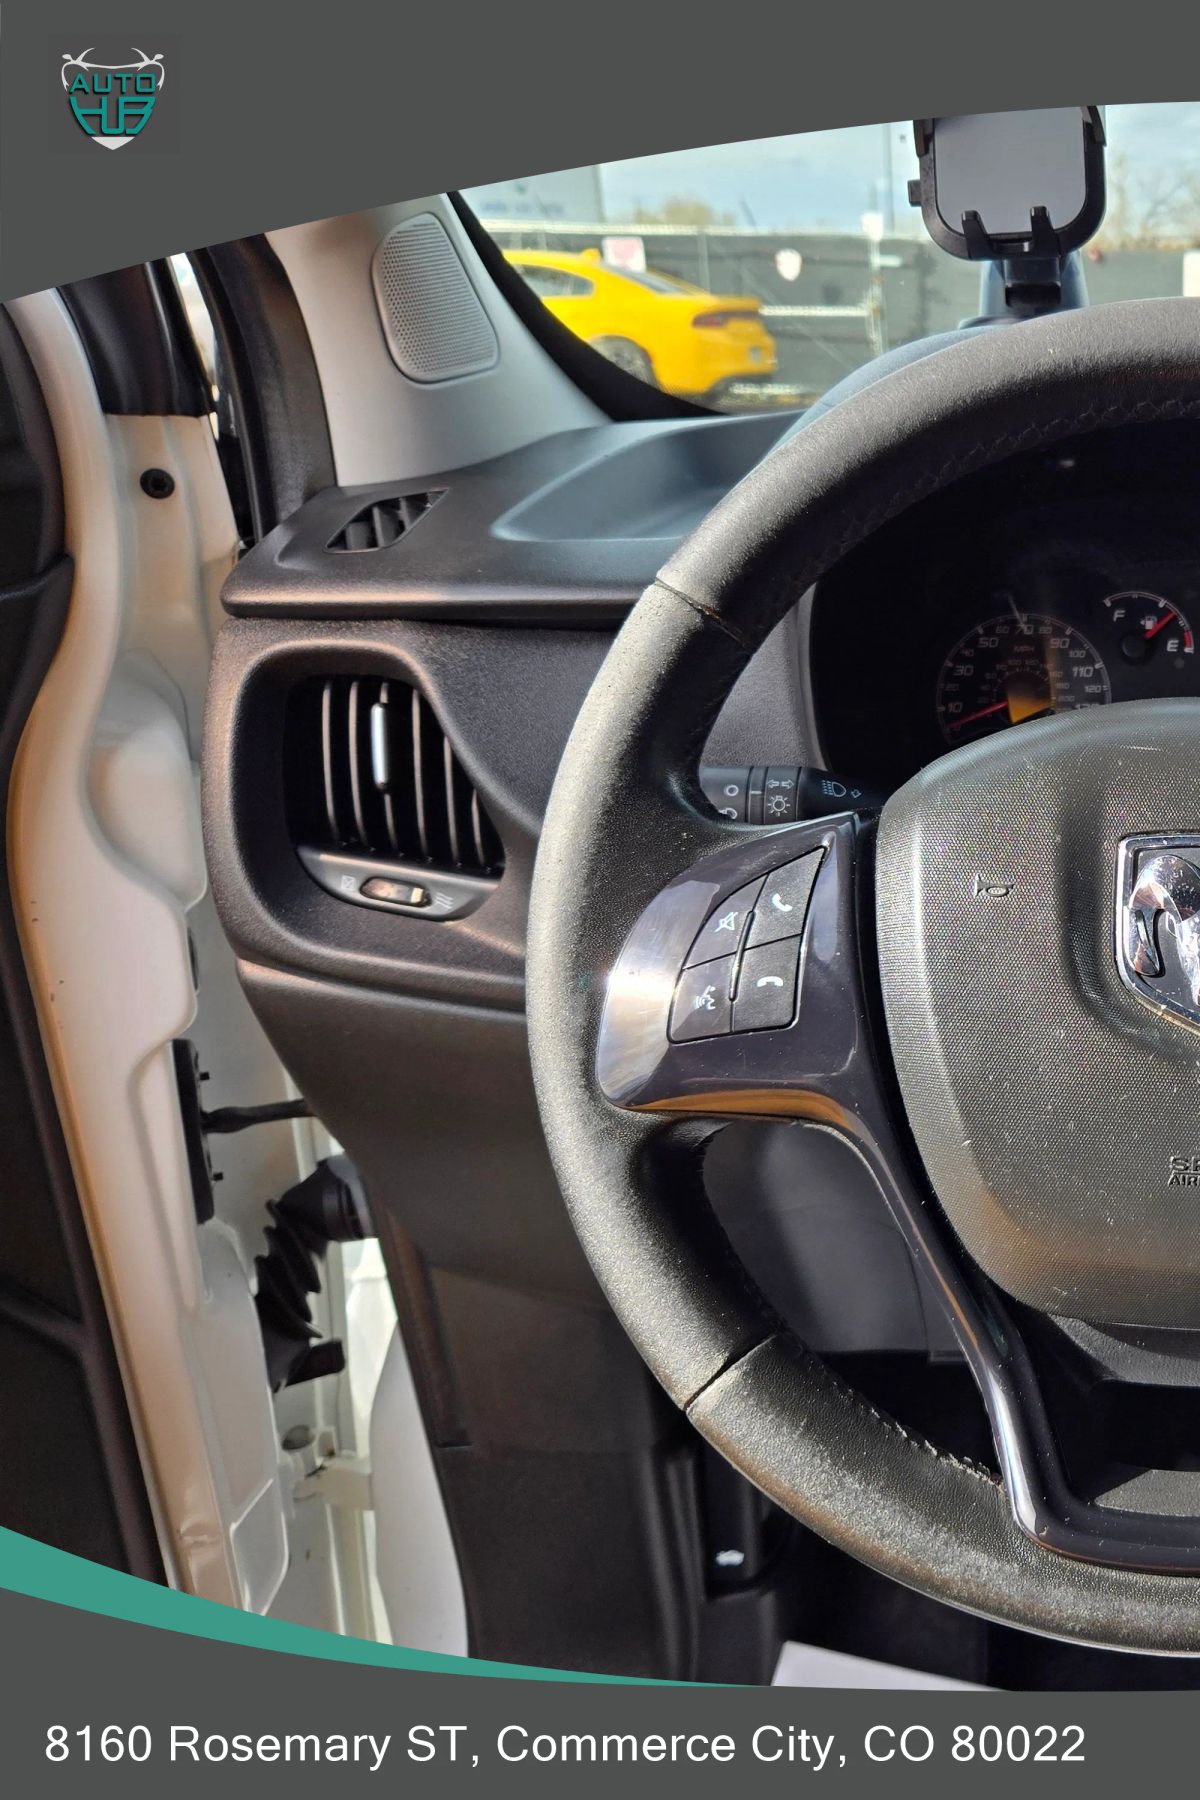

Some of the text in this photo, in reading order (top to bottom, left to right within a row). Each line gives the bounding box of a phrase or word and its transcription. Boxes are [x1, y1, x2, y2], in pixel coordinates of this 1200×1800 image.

[1113, 610, 1126, 622] F
[1015, 624, 1034, 635] 70
[978, 638, 999, 648] 50
[1050, 638, 1070, 648] 90
[1166, 639, 1179, 652] E
[953, 665, 974, 676] 30
[1072, 666, 1093, 677] 110
[1084, 685, 1101, 693] 120
[948, 702, 963, 713] 10
